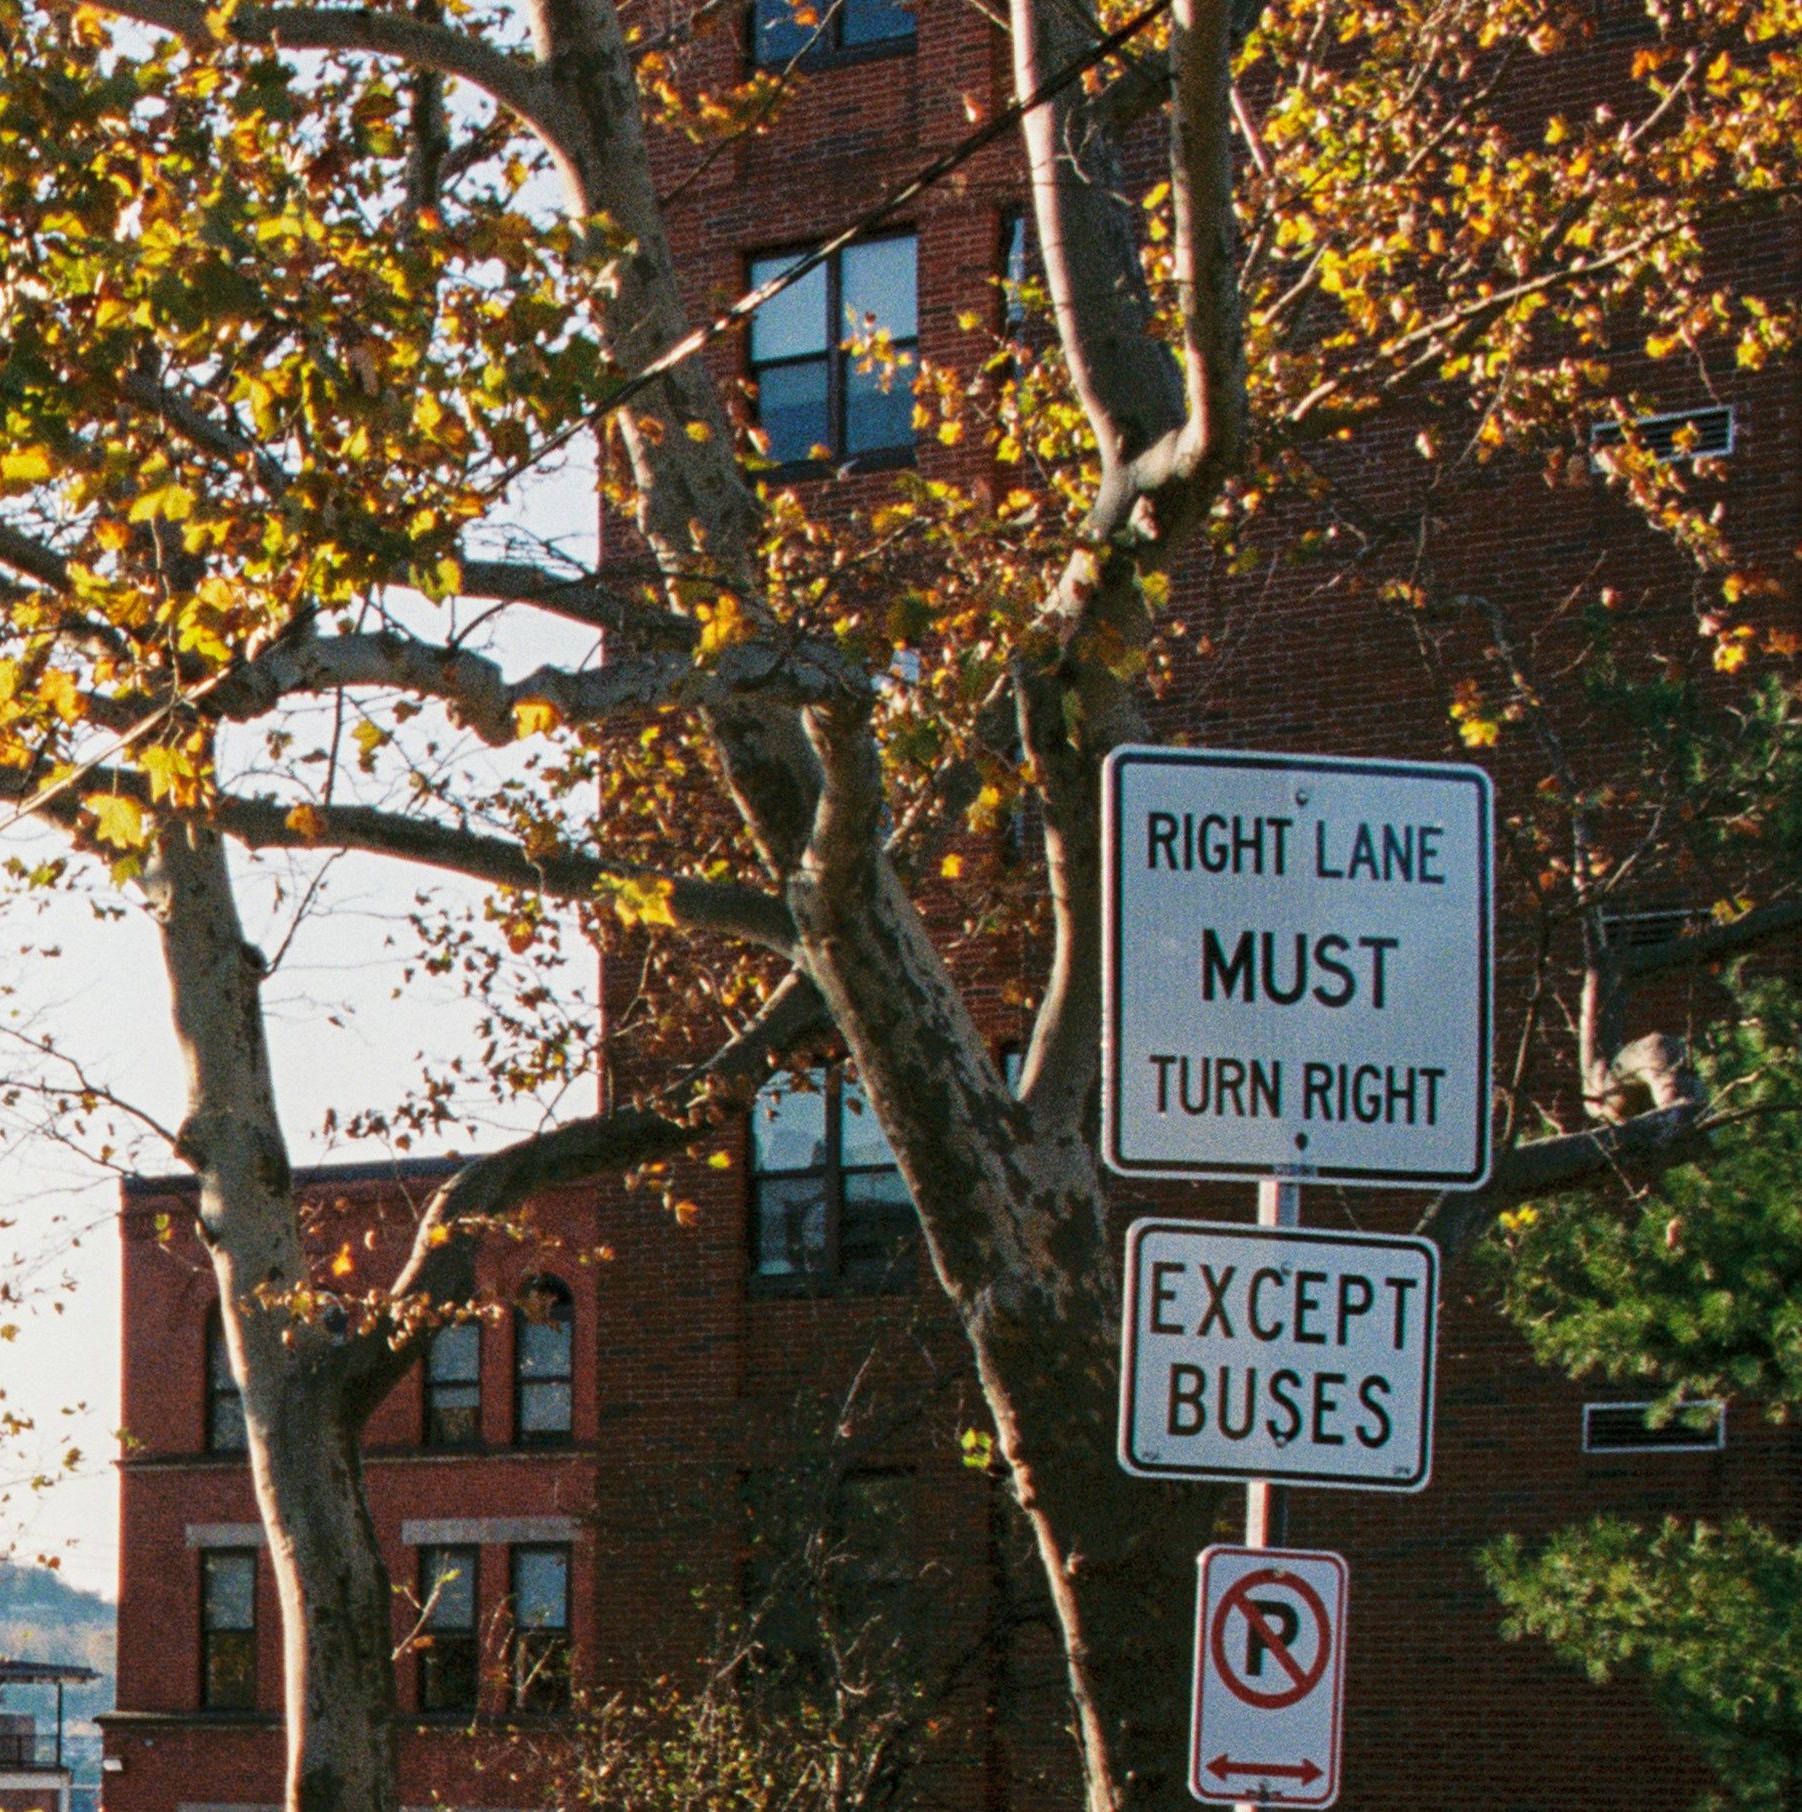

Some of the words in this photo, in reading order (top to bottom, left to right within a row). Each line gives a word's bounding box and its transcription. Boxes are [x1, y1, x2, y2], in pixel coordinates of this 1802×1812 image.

[1147, 810, 1293, 876] RIGHT
[1315, 819, 1446, 885] LANE
[1201, 927, 1400, 1010] MUST
[1148, 1053, 1283, 1119] TURN
[1303, 1061, 1446, 1126] RIGHT
[1149, 1260, 1418, 1350] EXCEPT
[1166, 1362, 1392, 1450] BUSES
